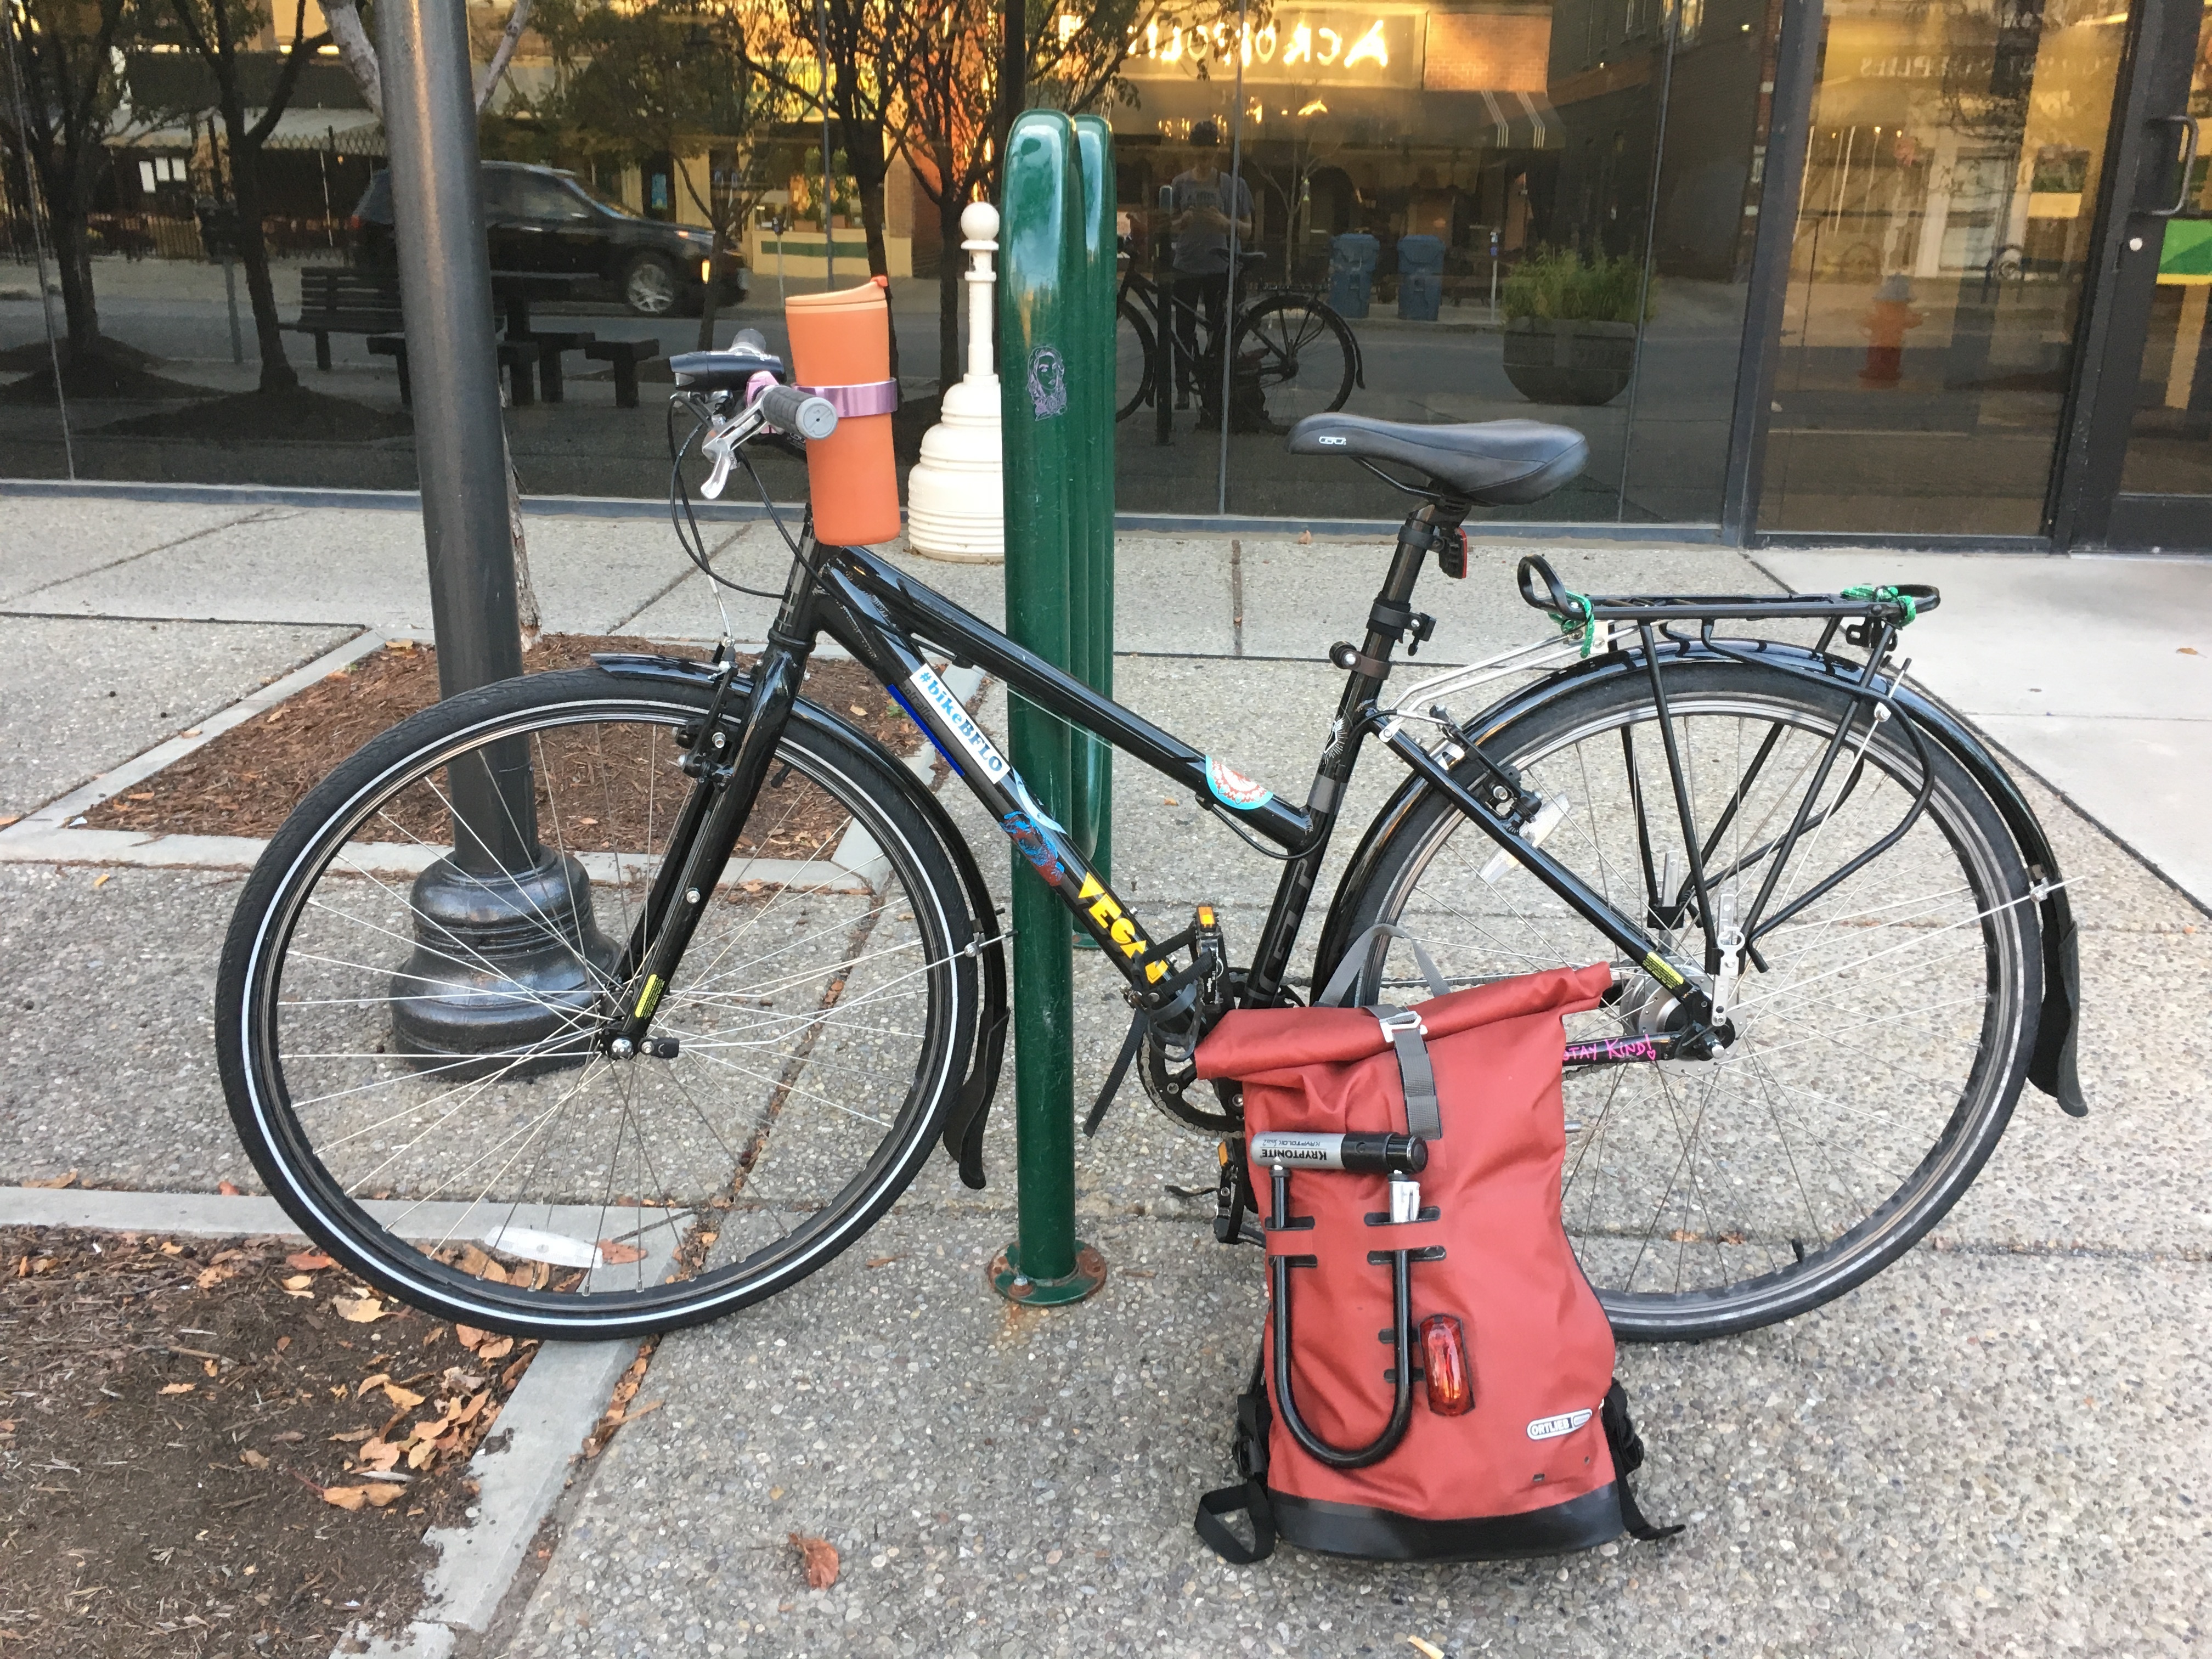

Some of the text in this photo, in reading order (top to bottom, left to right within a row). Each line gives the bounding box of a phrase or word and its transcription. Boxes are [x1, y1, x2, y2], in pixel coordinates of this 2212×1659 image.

[919, 672, 1002, 771] #bikeBFLO
[1078, 871, 1169, 984] VEGAN
[1261, 1149, 1327, 1160] KRYPTONITE
[1531, 1418, 1570, 1436] ORTLIEB
